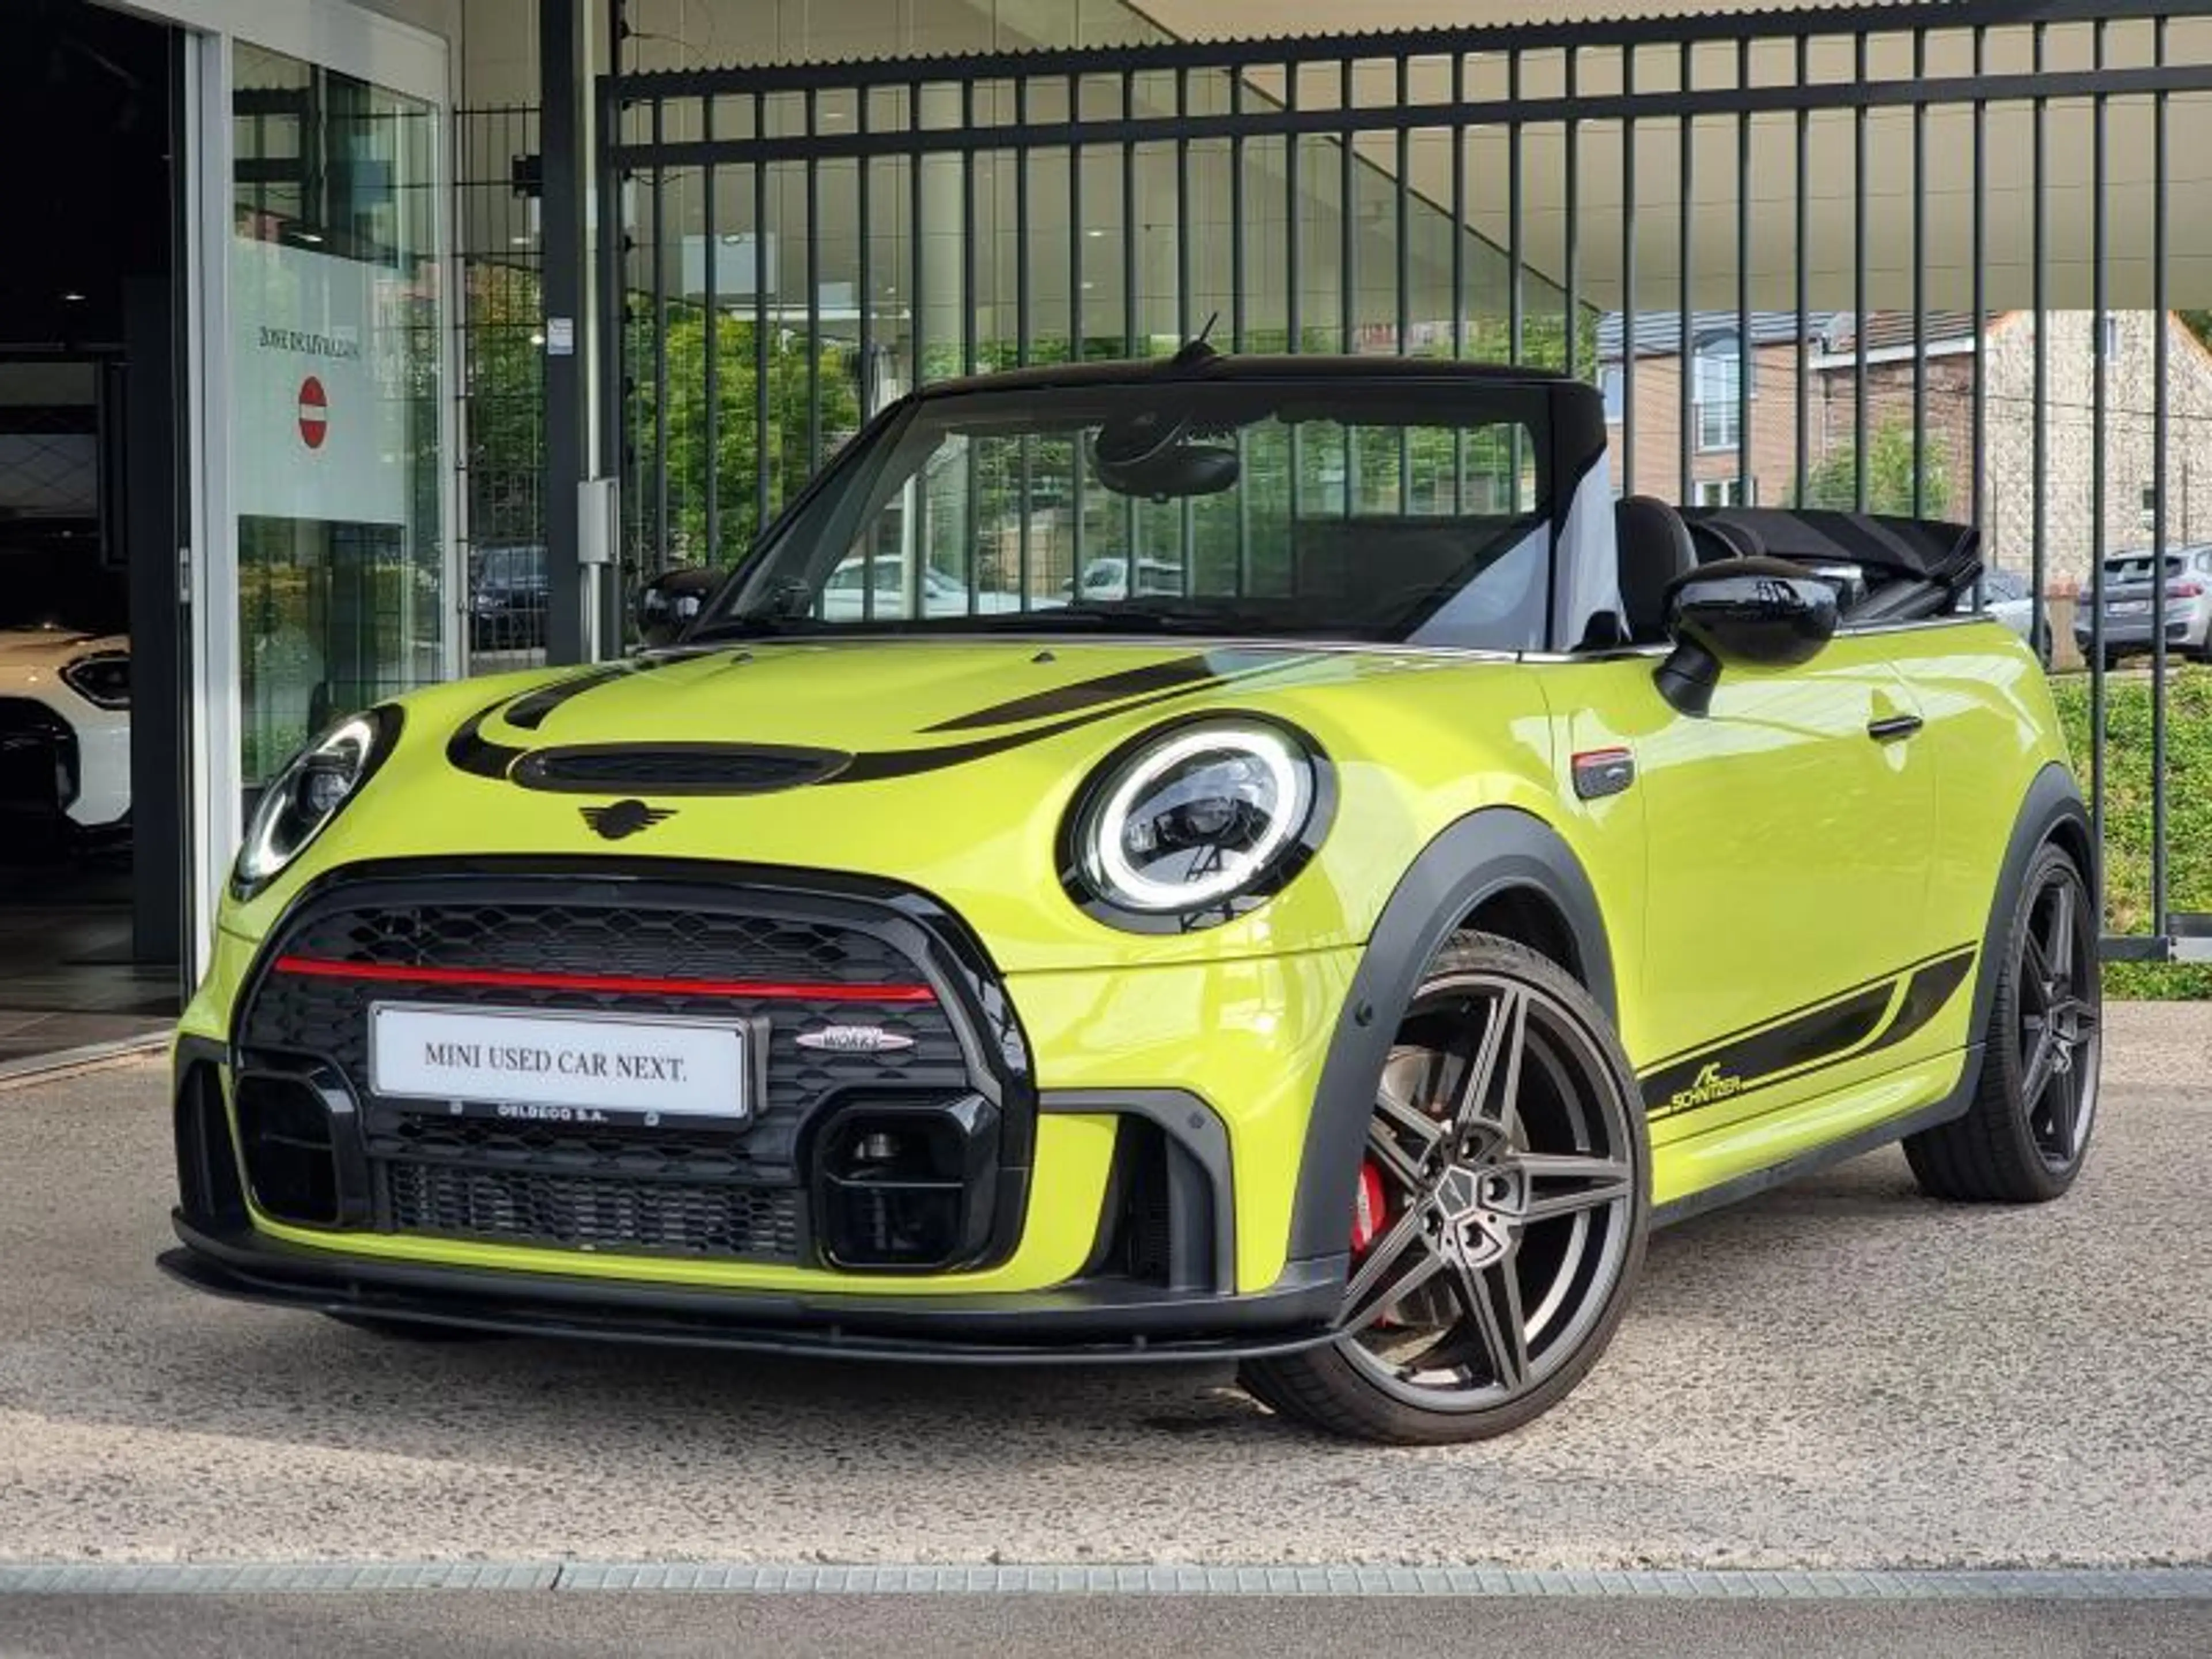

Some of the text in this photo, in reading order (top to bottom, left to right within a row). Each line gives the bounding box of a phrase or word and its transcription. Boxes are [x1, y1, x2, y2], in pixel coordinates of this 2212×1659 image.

[425, 1042, 688, 1082] MINI USED CAR NEXT.
